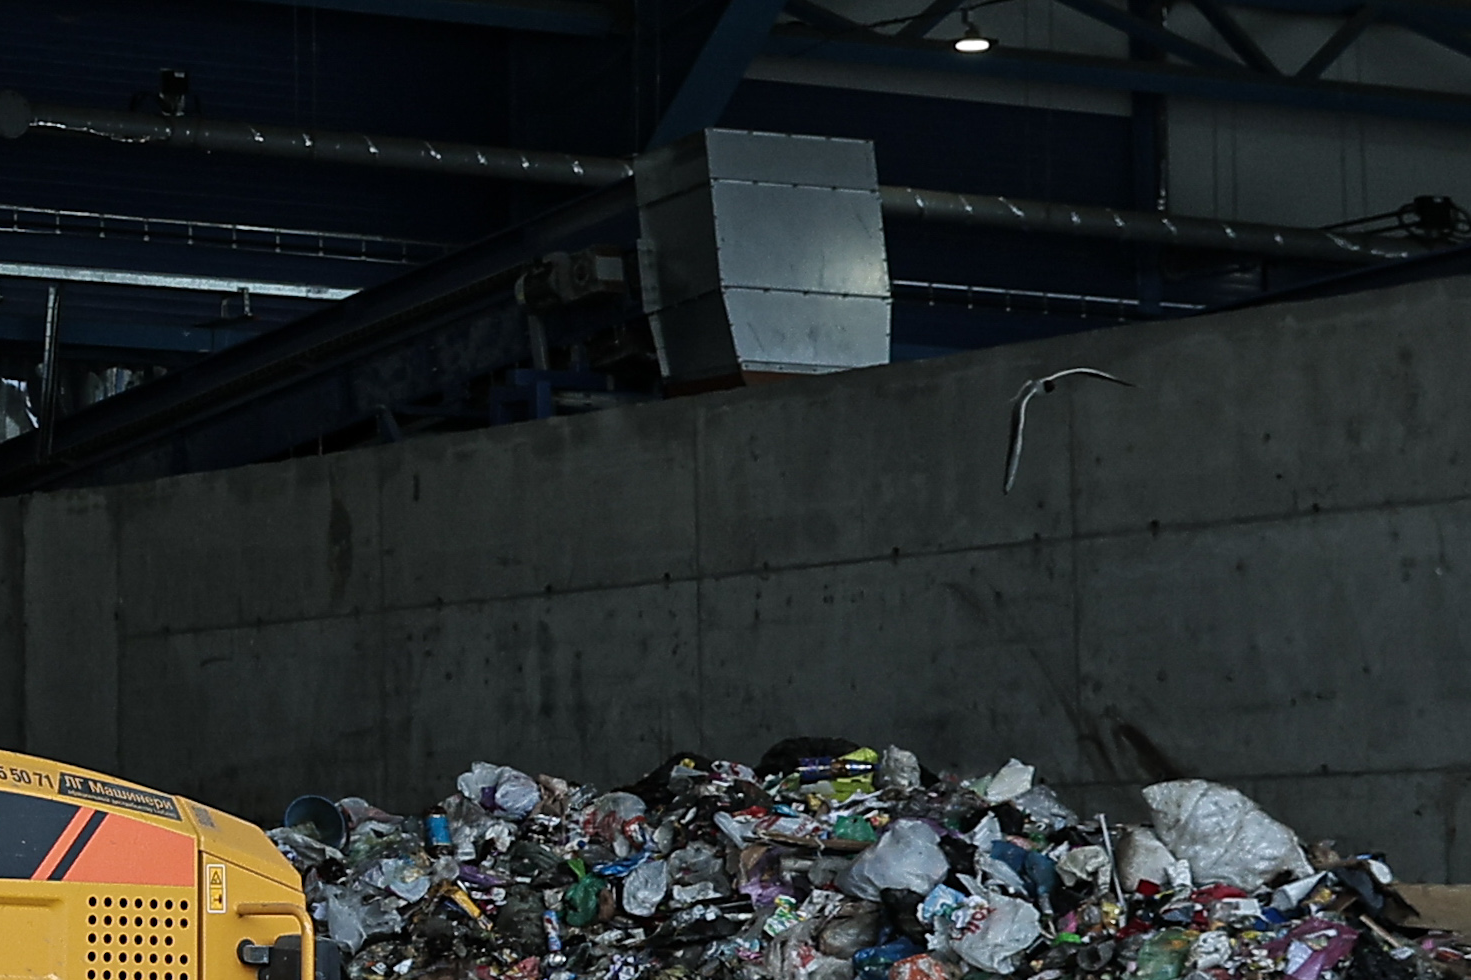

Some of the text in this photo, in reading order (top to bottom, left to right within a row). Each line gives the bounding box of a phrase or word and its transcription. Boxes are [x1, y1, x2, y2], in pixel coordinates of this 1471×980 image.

[10, 768, 32, 784] 50
[33, 772, 54, 789] 71
[88, 780, 174, 811] Машинери
